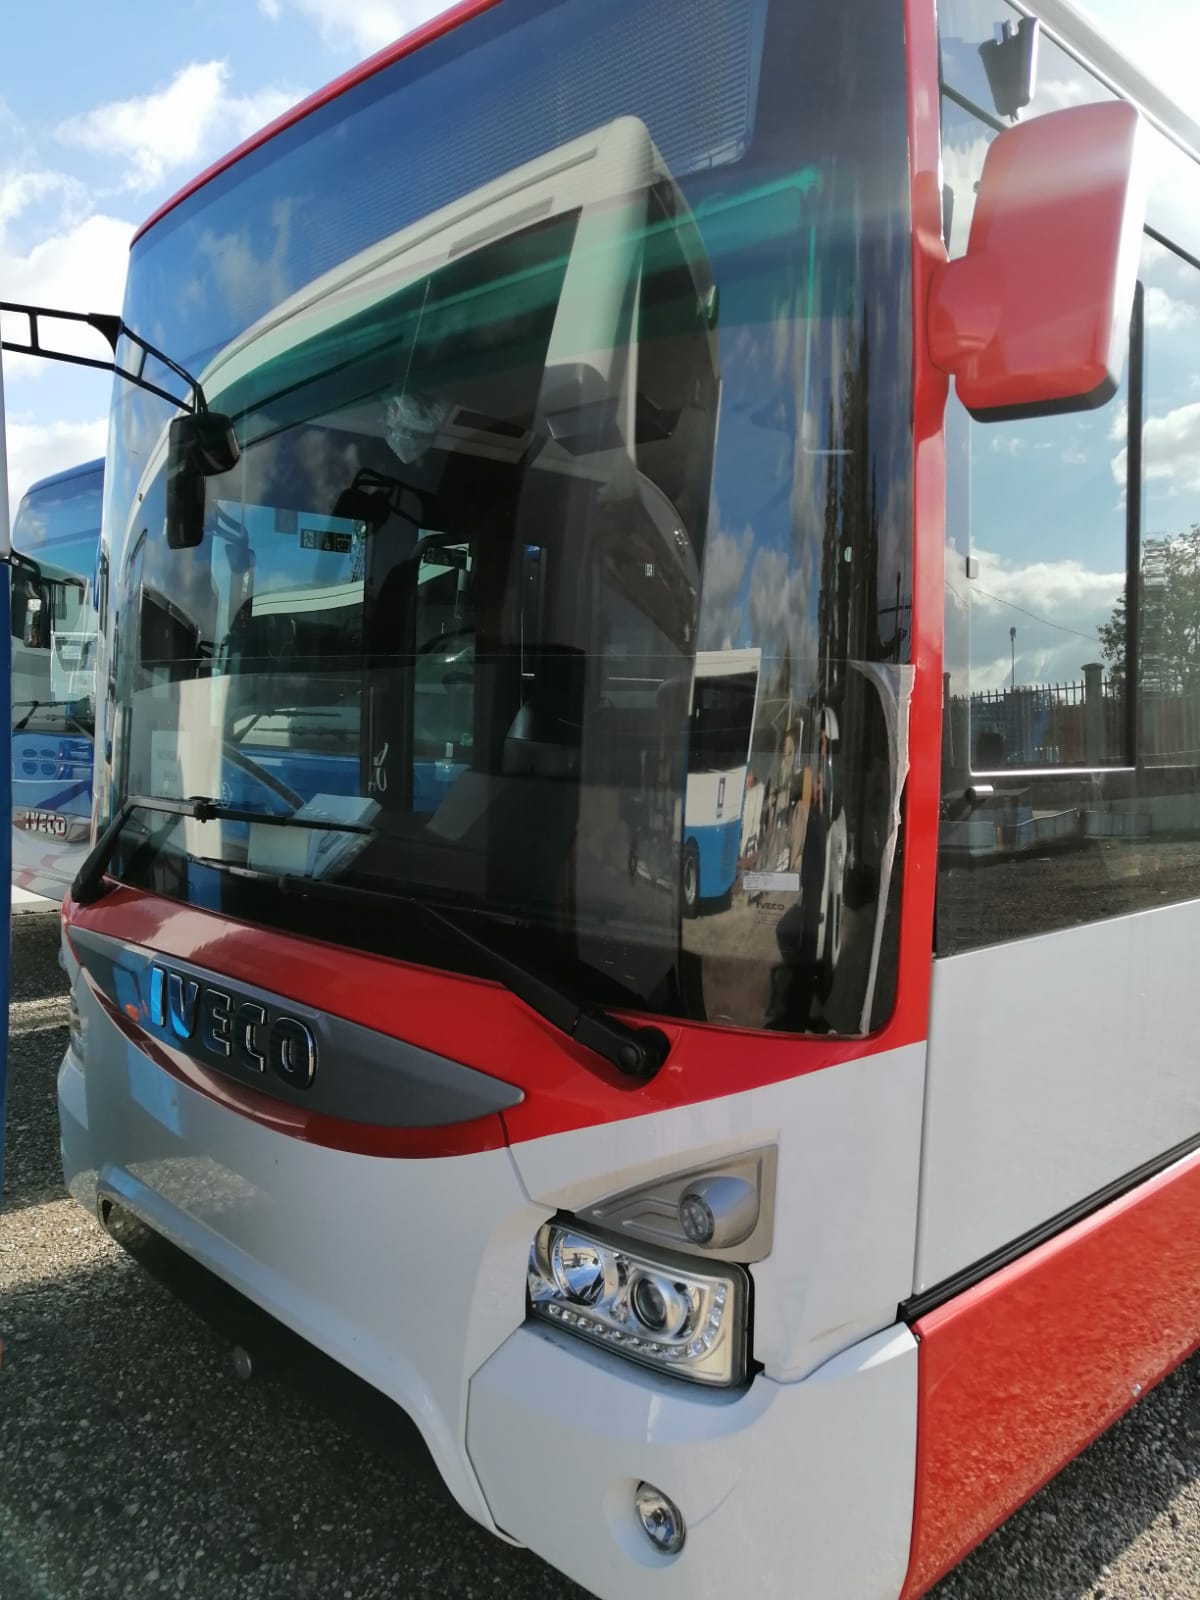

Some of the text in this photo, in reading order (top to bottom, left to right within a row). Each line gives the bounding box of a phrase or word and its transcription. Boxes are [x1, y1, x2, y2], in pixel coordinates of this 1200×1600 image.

[25, 811, 66, 836] IVECO
[756, 901, 785, 910] IVECO
[151, 967, 318, 1089] IVECO
